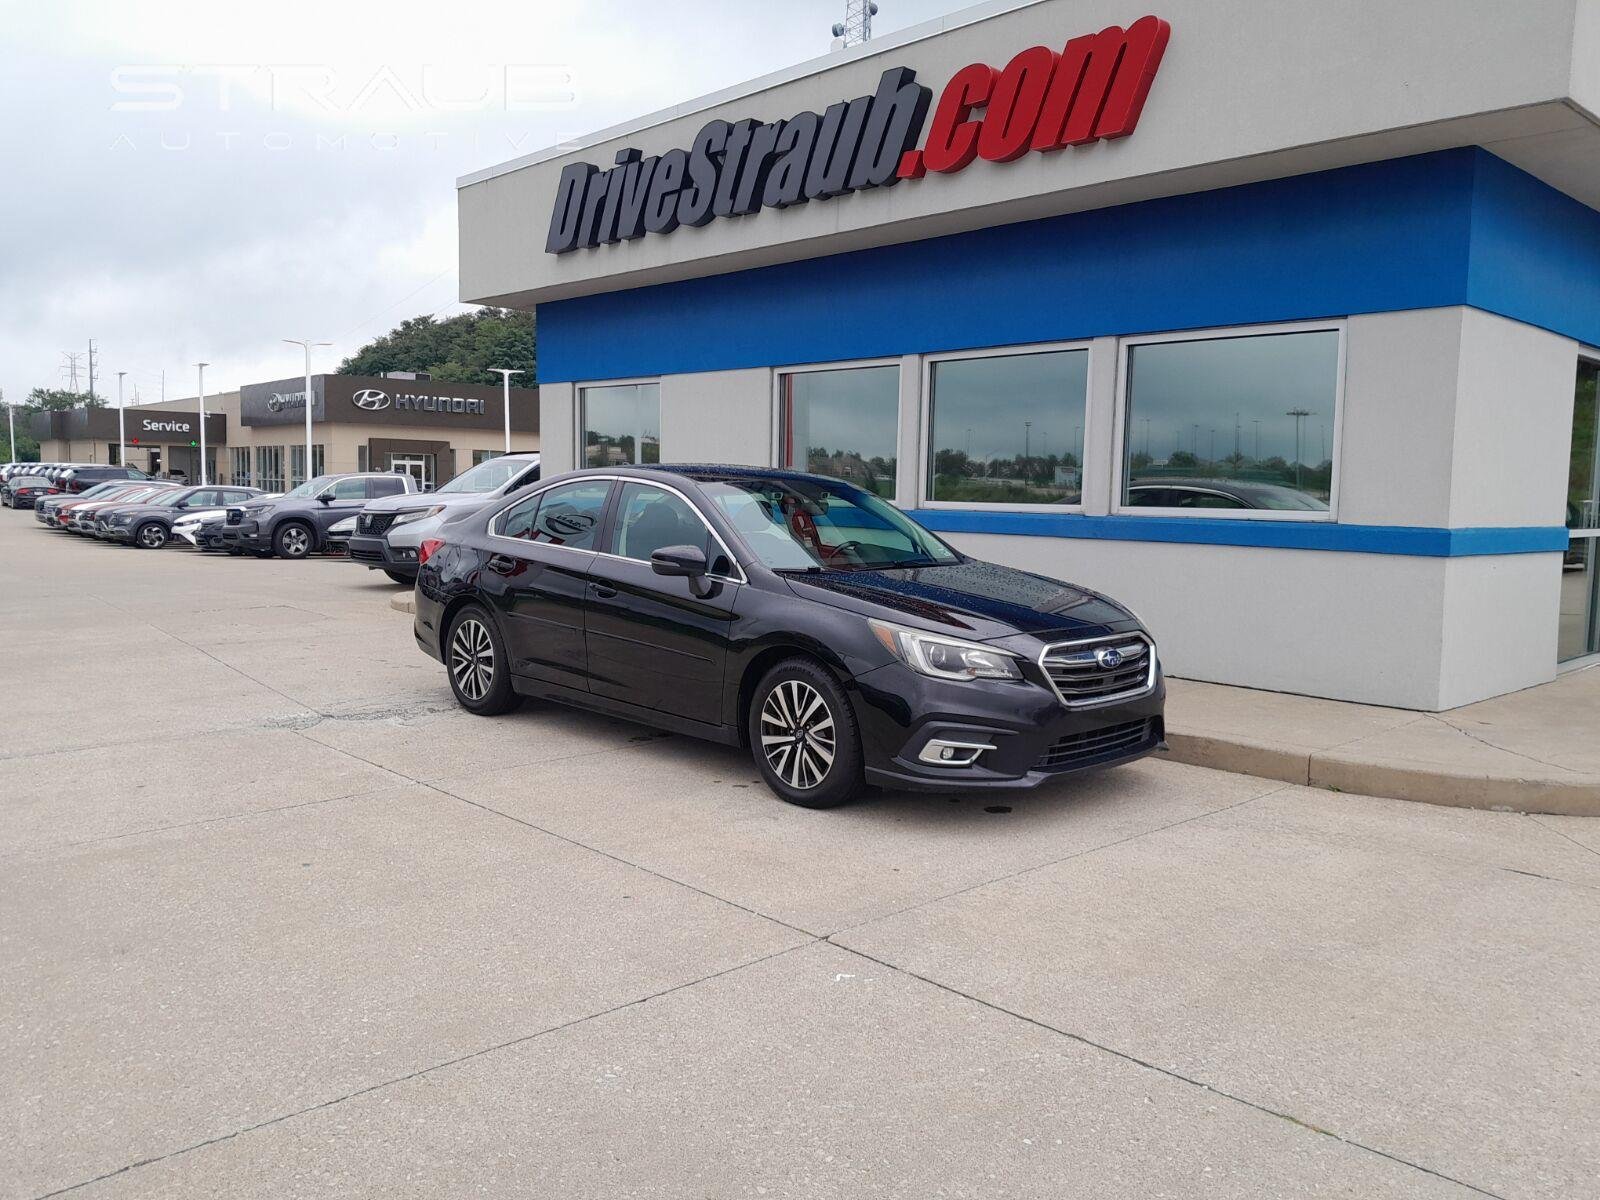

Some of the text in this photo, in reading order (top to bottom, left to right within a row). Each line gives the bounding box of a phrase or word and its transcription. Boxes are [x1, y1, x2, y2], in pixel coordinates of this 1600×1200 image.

[545, 15, 1171, 254] DriveStraub.com
[395, 393, 485, 414] HYUNDAI
[142, 419, 190, 432] Service
